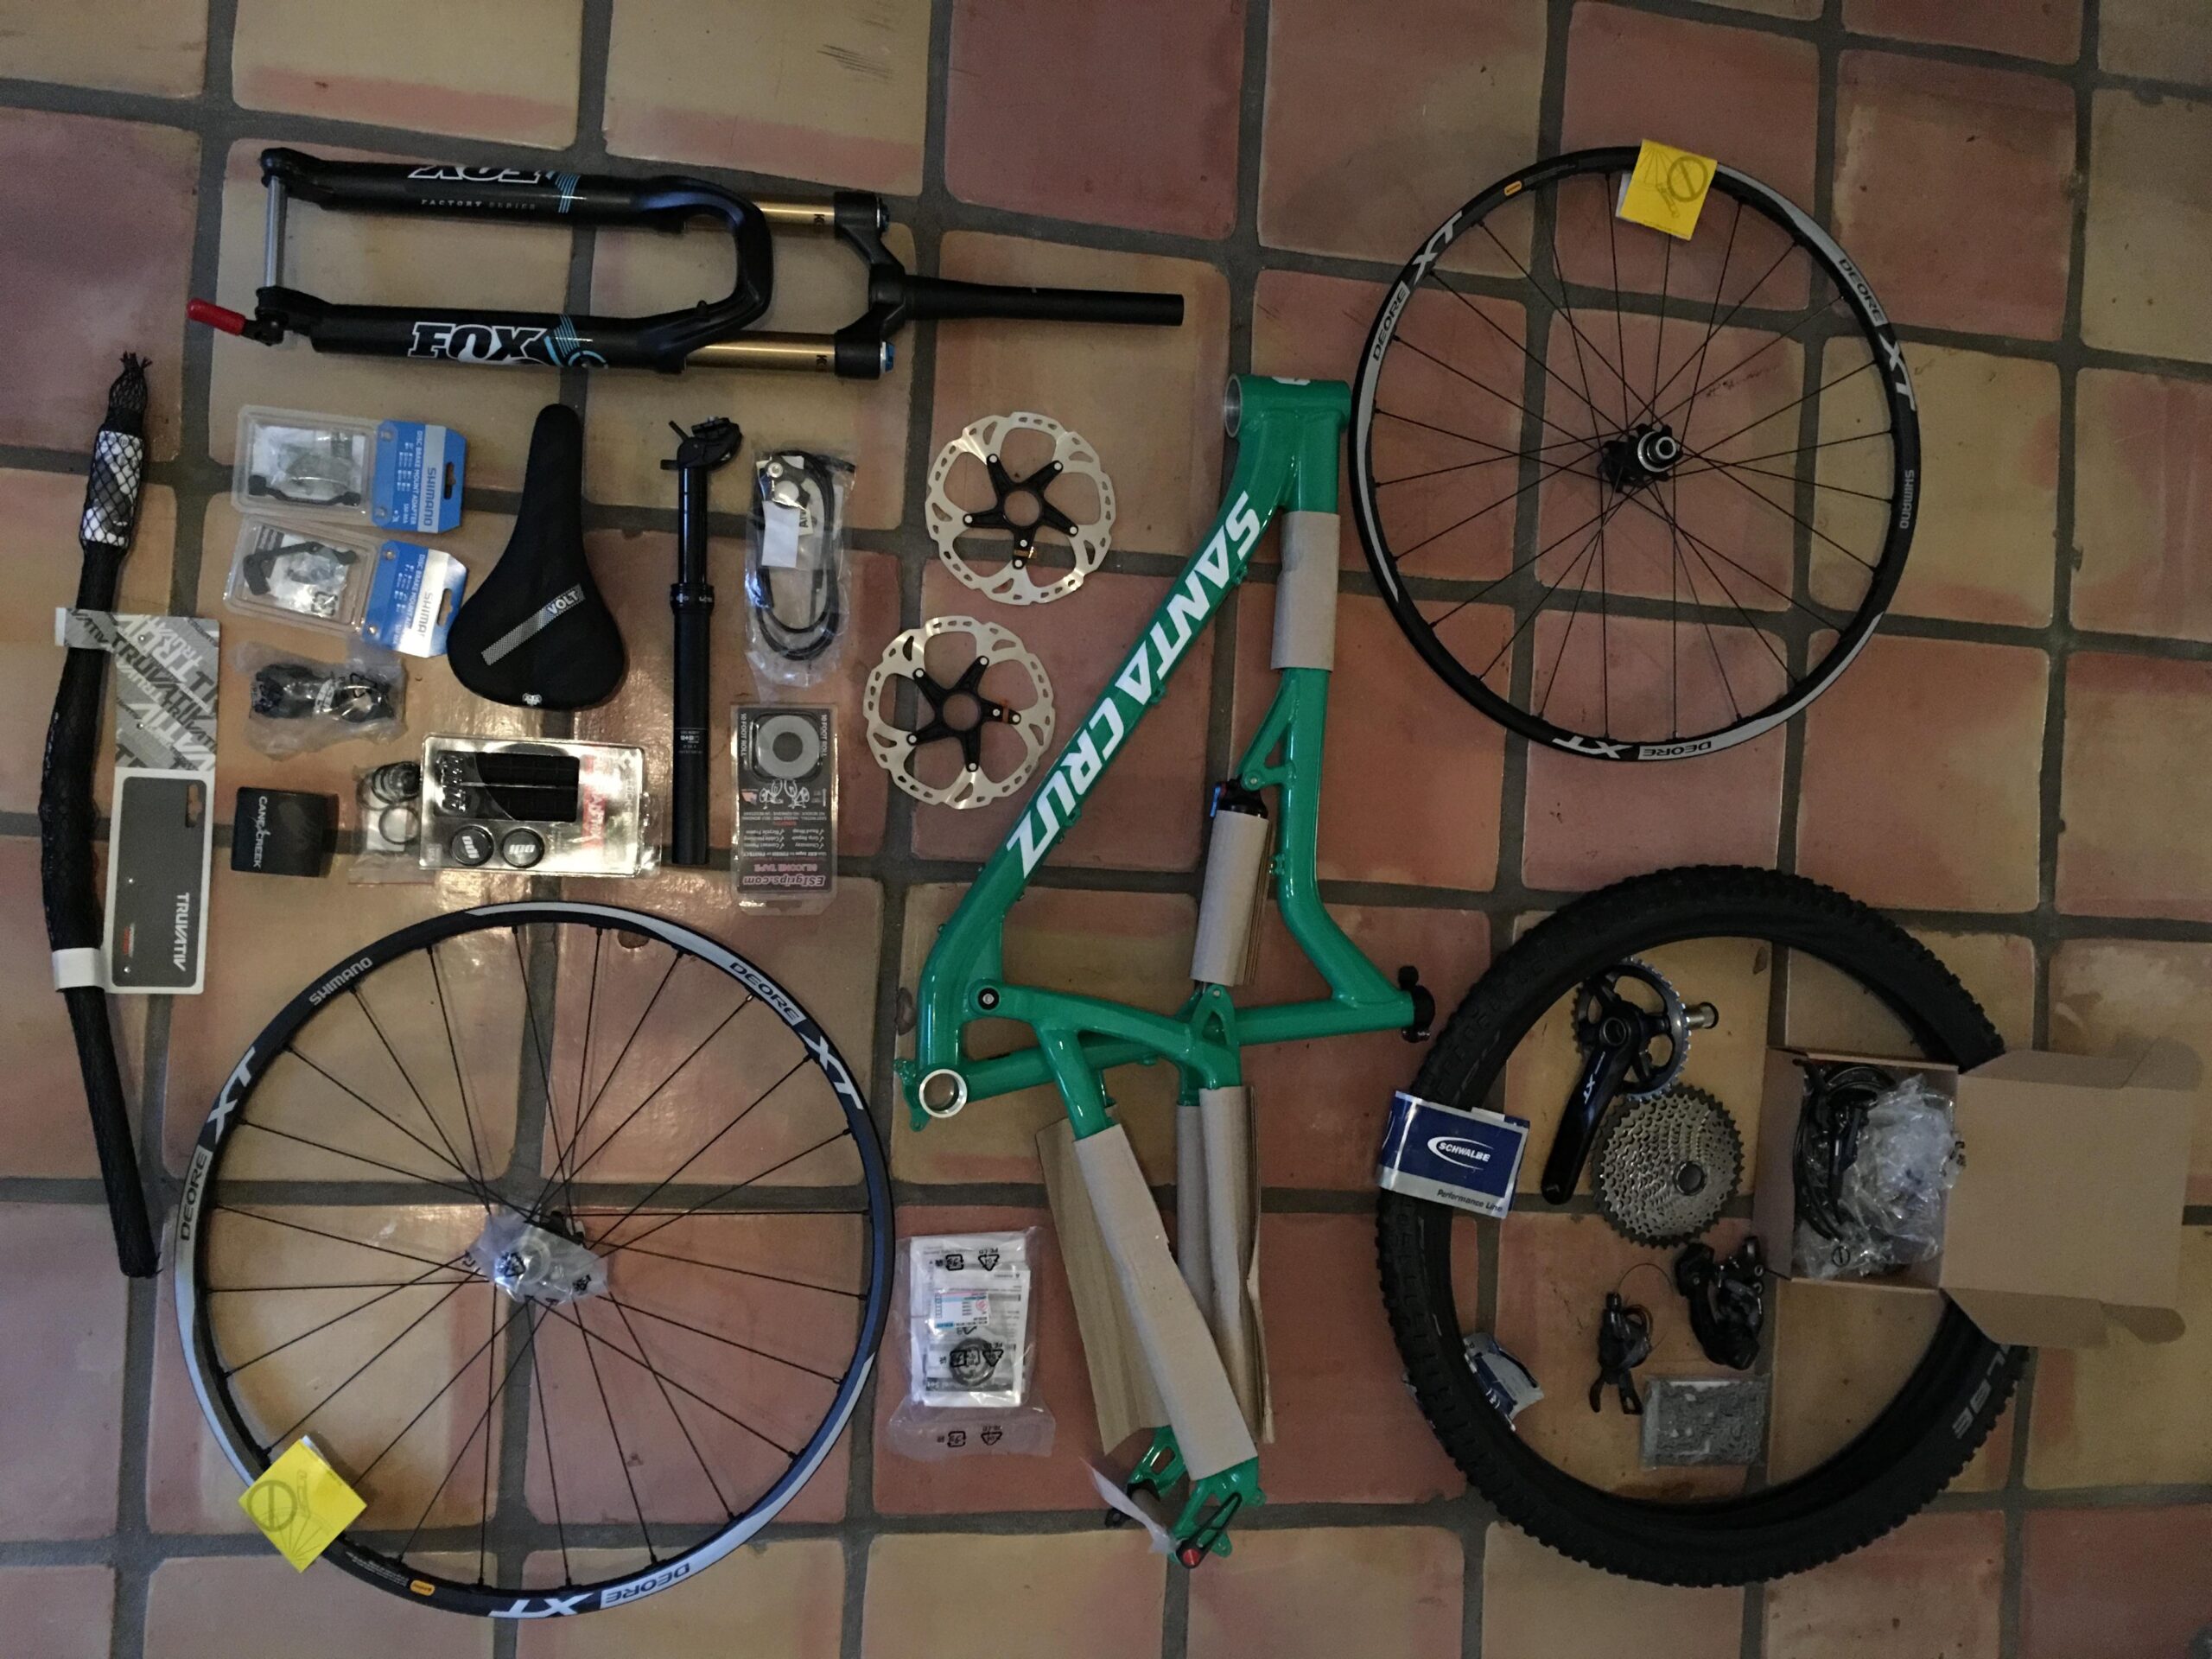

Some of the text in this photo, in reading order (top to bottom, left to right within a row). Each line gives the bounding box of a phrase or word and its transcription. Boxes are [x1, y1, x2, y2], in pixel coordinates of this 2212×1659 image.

[421, 198, 537, 211] FACTORY SERIES
[1412, 210, 1463, 285] XT
[1839, 258, 1885, 321] DEORE
[408, 321, 548, 366] FOX
[1373, 287, 1406, 361] DEORE
[1878, 334, 1916, 412] XT
[423, 467, 437, 526] SHIMANO
[1899, 469, 1915, 530] SHIMANO
[545, 590, 579, 614] VOLT
[1006, 490, 1261, 880] SANTA CRUZ
[1552, 735, 1633, 760] XT
[1643, 741, 1713, 756] DEORE
[253, 796, 268, 869] CANE CREEK
[741, 872, 826, 887] ESIgrips.com
[753, 862, 817, 872] SILICONE TAPE
[173, 893, 190, 972] TRUVATIV
[309, 957, 373, 1006] SHIMANO
[729, 962, 799, 1020] DEORE
[207, 1046, 256, 1143] XT
[798, 1032, 864, 1111] XT
[1583, 1072, 1596, 1104] XT
[1438, 1141, 1491, 1163] SCHWALBE
[180, 1150, 208, 1242] DEORE
[1437, 1188, 1484, 1208] Performance
[489, 1592, 594, 1619] XT
[606, 1562, 691, 1603] DEORE
